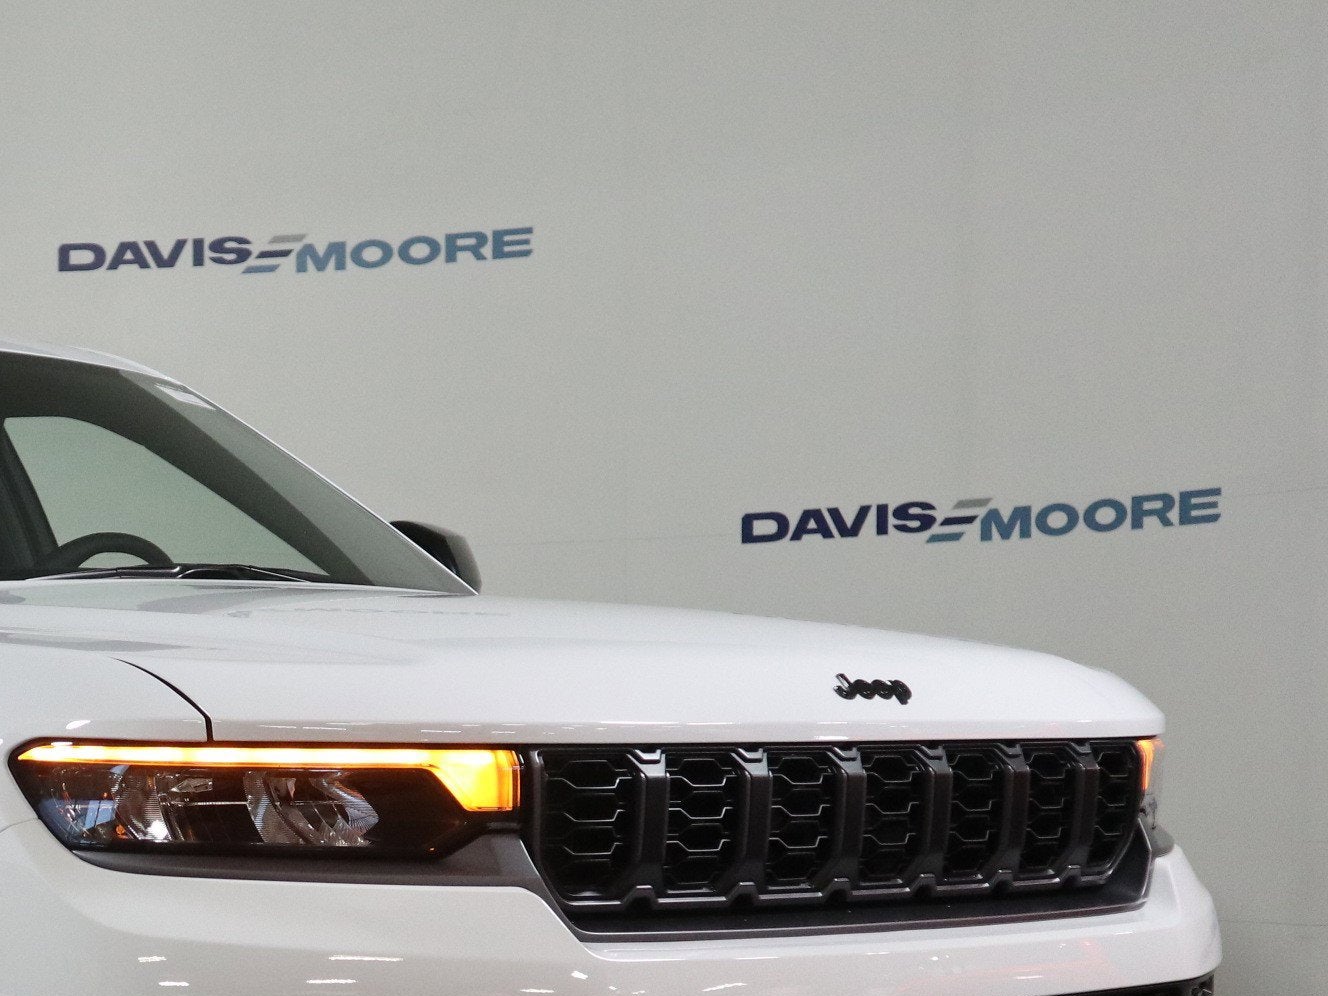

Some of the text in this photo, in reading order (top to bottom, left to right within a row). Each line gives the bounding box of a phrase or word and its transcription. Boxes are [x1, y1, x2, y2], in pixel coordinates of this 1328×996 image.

[58, 227, 534, 273] DAVIS MOORE
[741, 487, 1222, 544] DAVIS MOORE
[833, 673, 912, 705] Jeep
